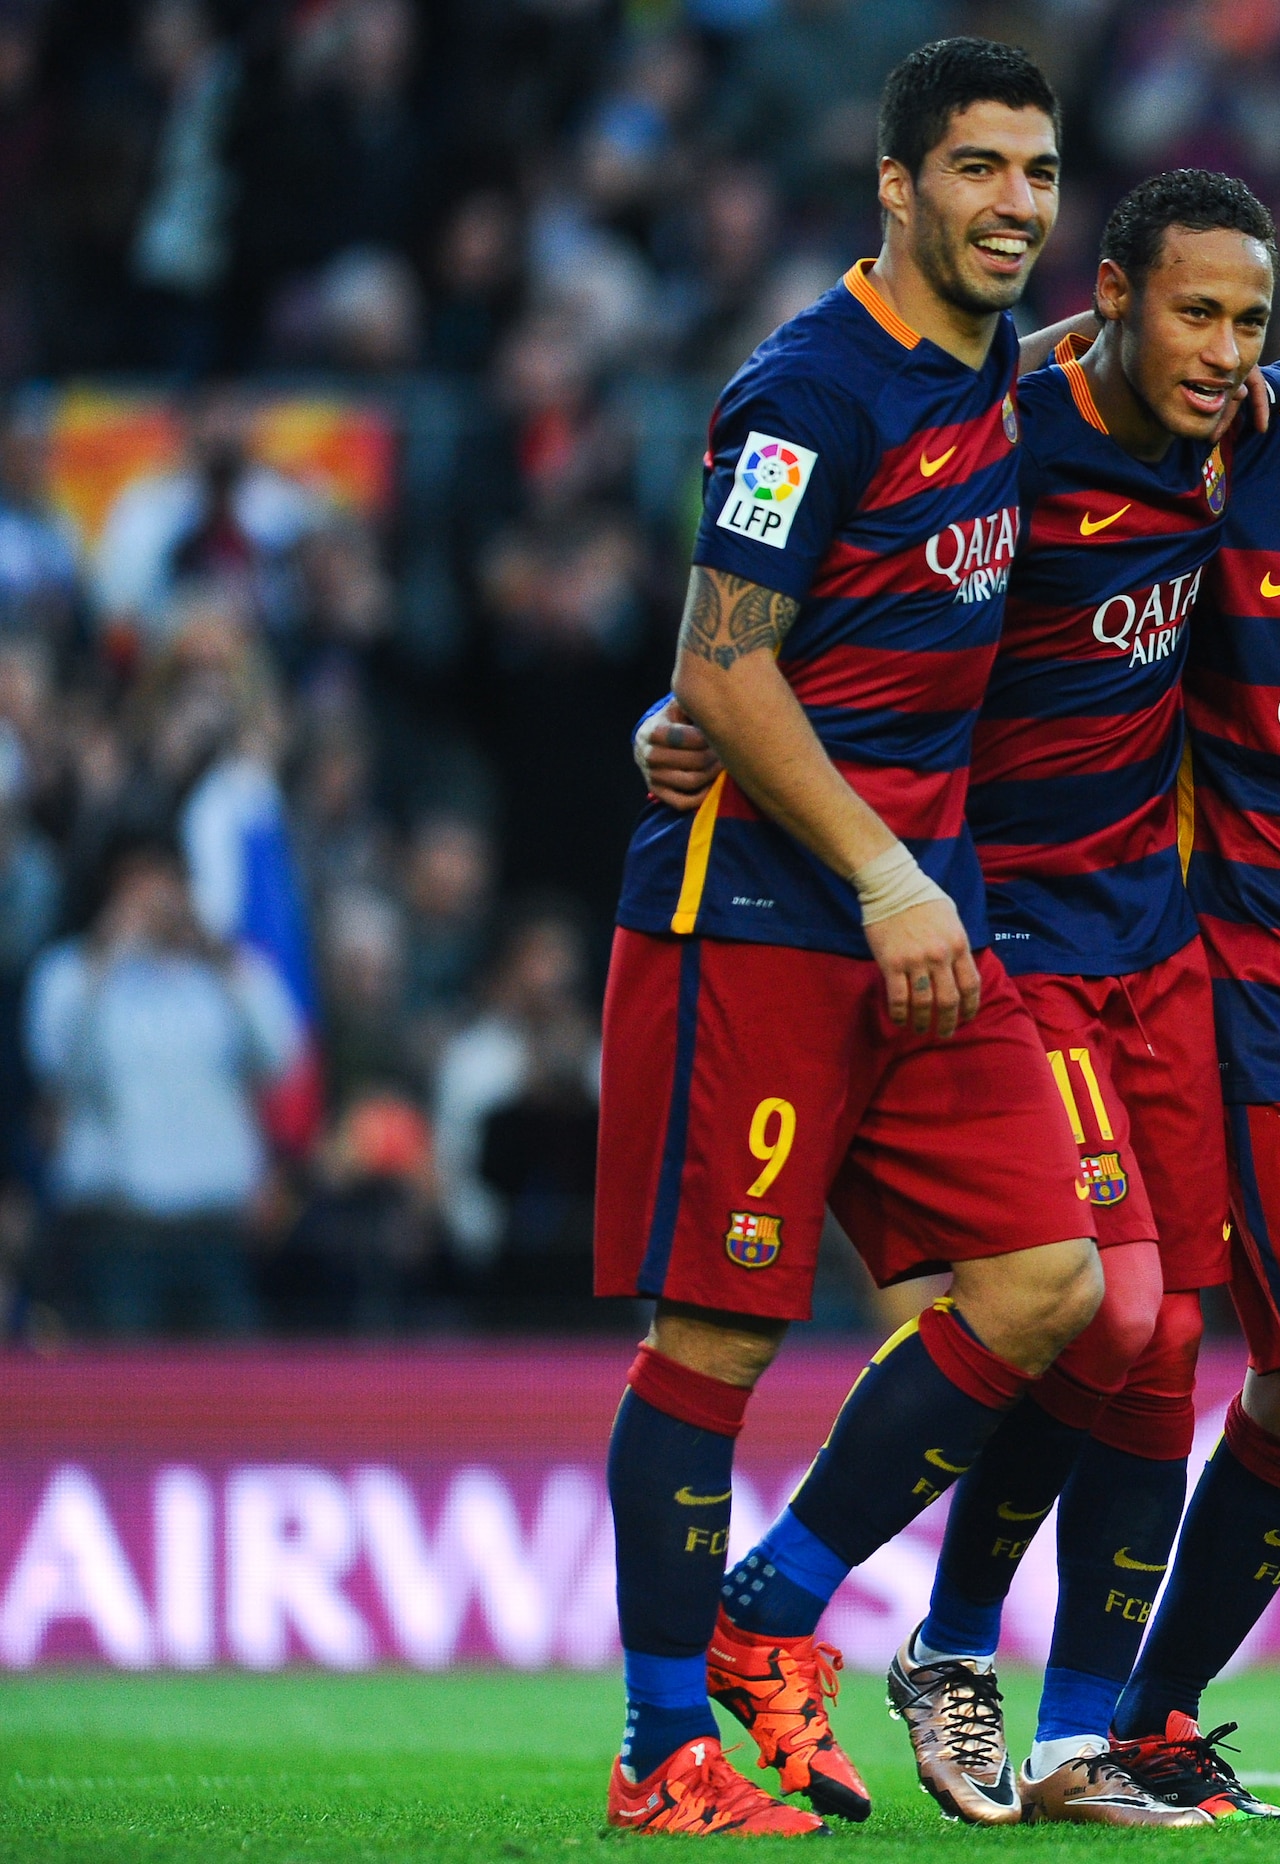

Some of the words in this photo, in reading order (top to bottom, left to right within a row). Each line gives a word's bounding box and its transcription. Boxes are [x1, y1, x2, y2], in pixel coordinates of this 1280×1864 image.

[729, 500, 782, 537] LFP
[994, 932, 1031, 941] DRI-FIT
[1046, 1047, 1114, 1144] 11
[746, 1097, 797, 1198] 9
[684, 1526, 730, 1555] FC
[991, 1537, 1031, 1559] FC
[1105, 1589, 1153, 1624] FCB
